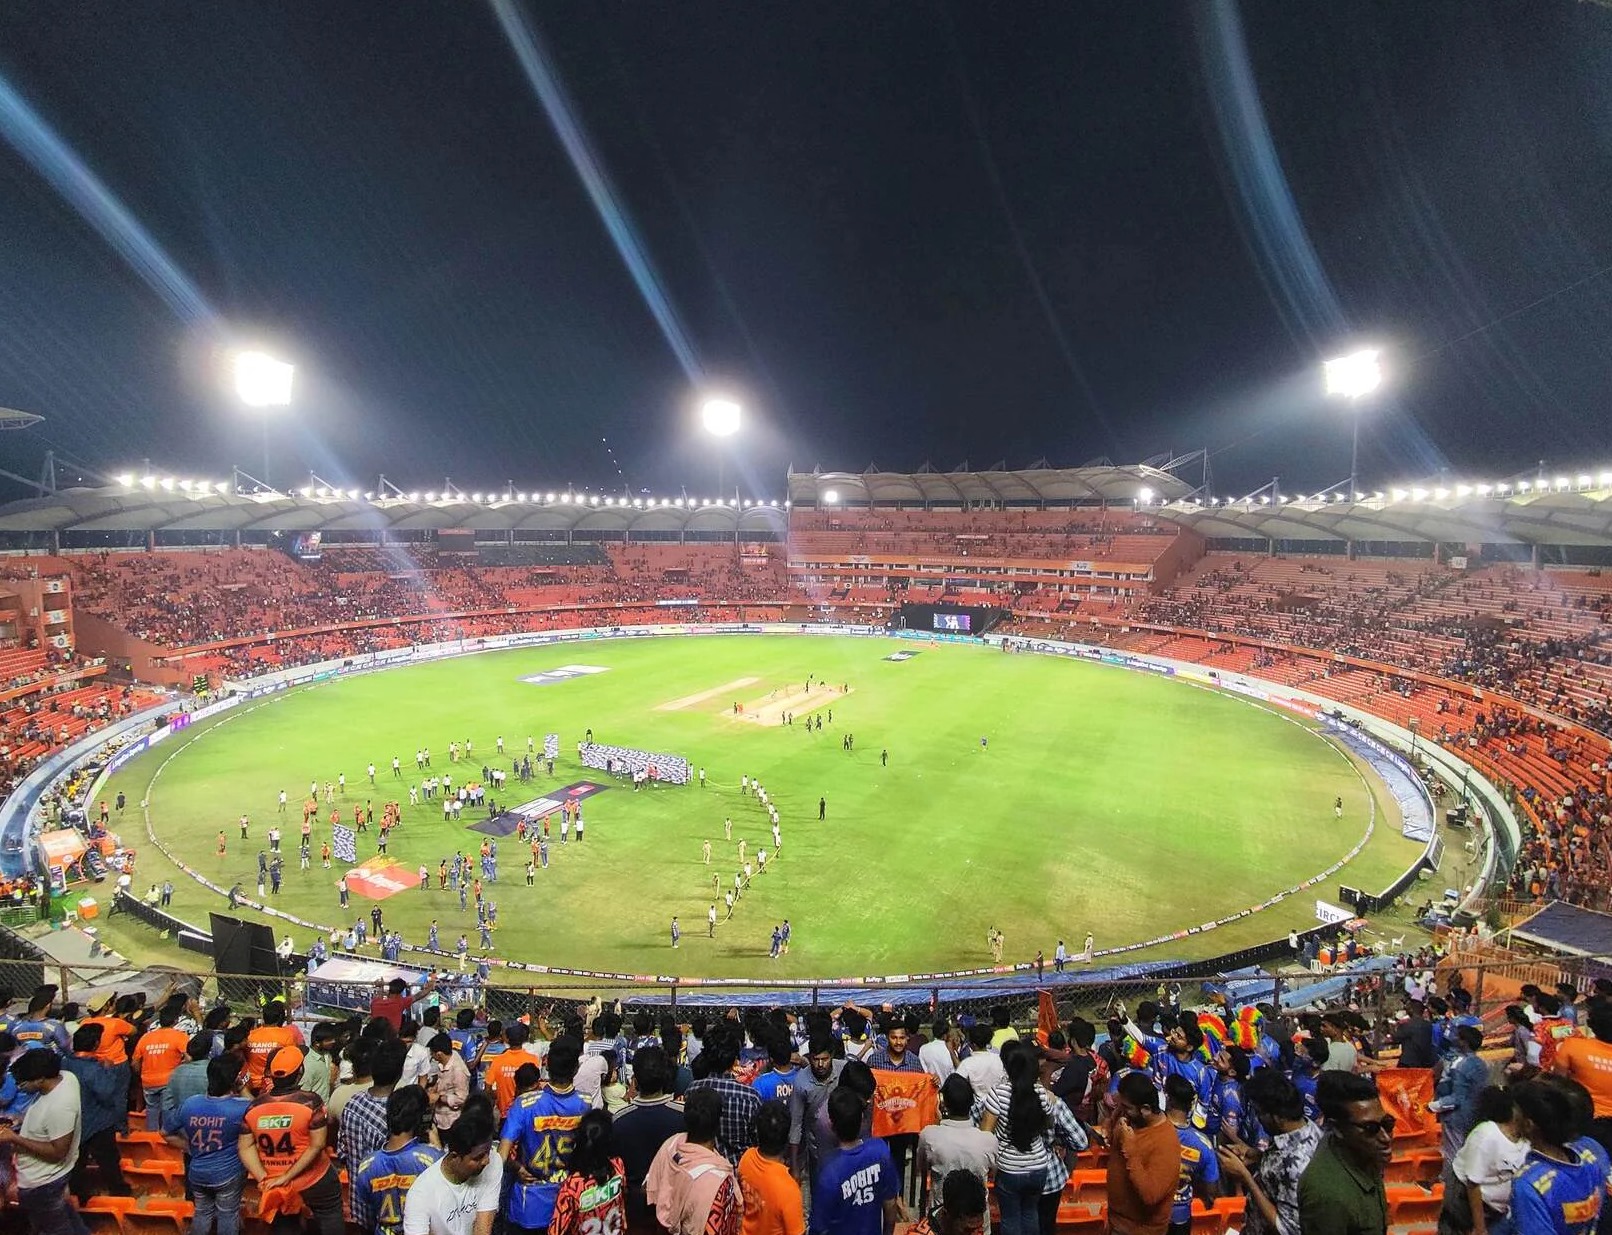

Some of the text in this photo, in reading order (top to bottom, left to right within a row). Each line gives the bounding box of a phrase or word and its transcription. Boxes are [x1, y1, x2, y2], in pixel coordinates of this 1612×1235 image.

[776, 1084, 794, 1098] ROH
[190, 1116, 226, 1127] ROHIT
[257, 1116, 292, 1129] BKT
[191, 1129, 223, 1152] 45
[258, 1132, 296, 1157] 94
[581, 1179, 621, 1206] BKT
[841, 1164, 881, 1200] ROHIT
[852, 1186, 875, 1206] 45
